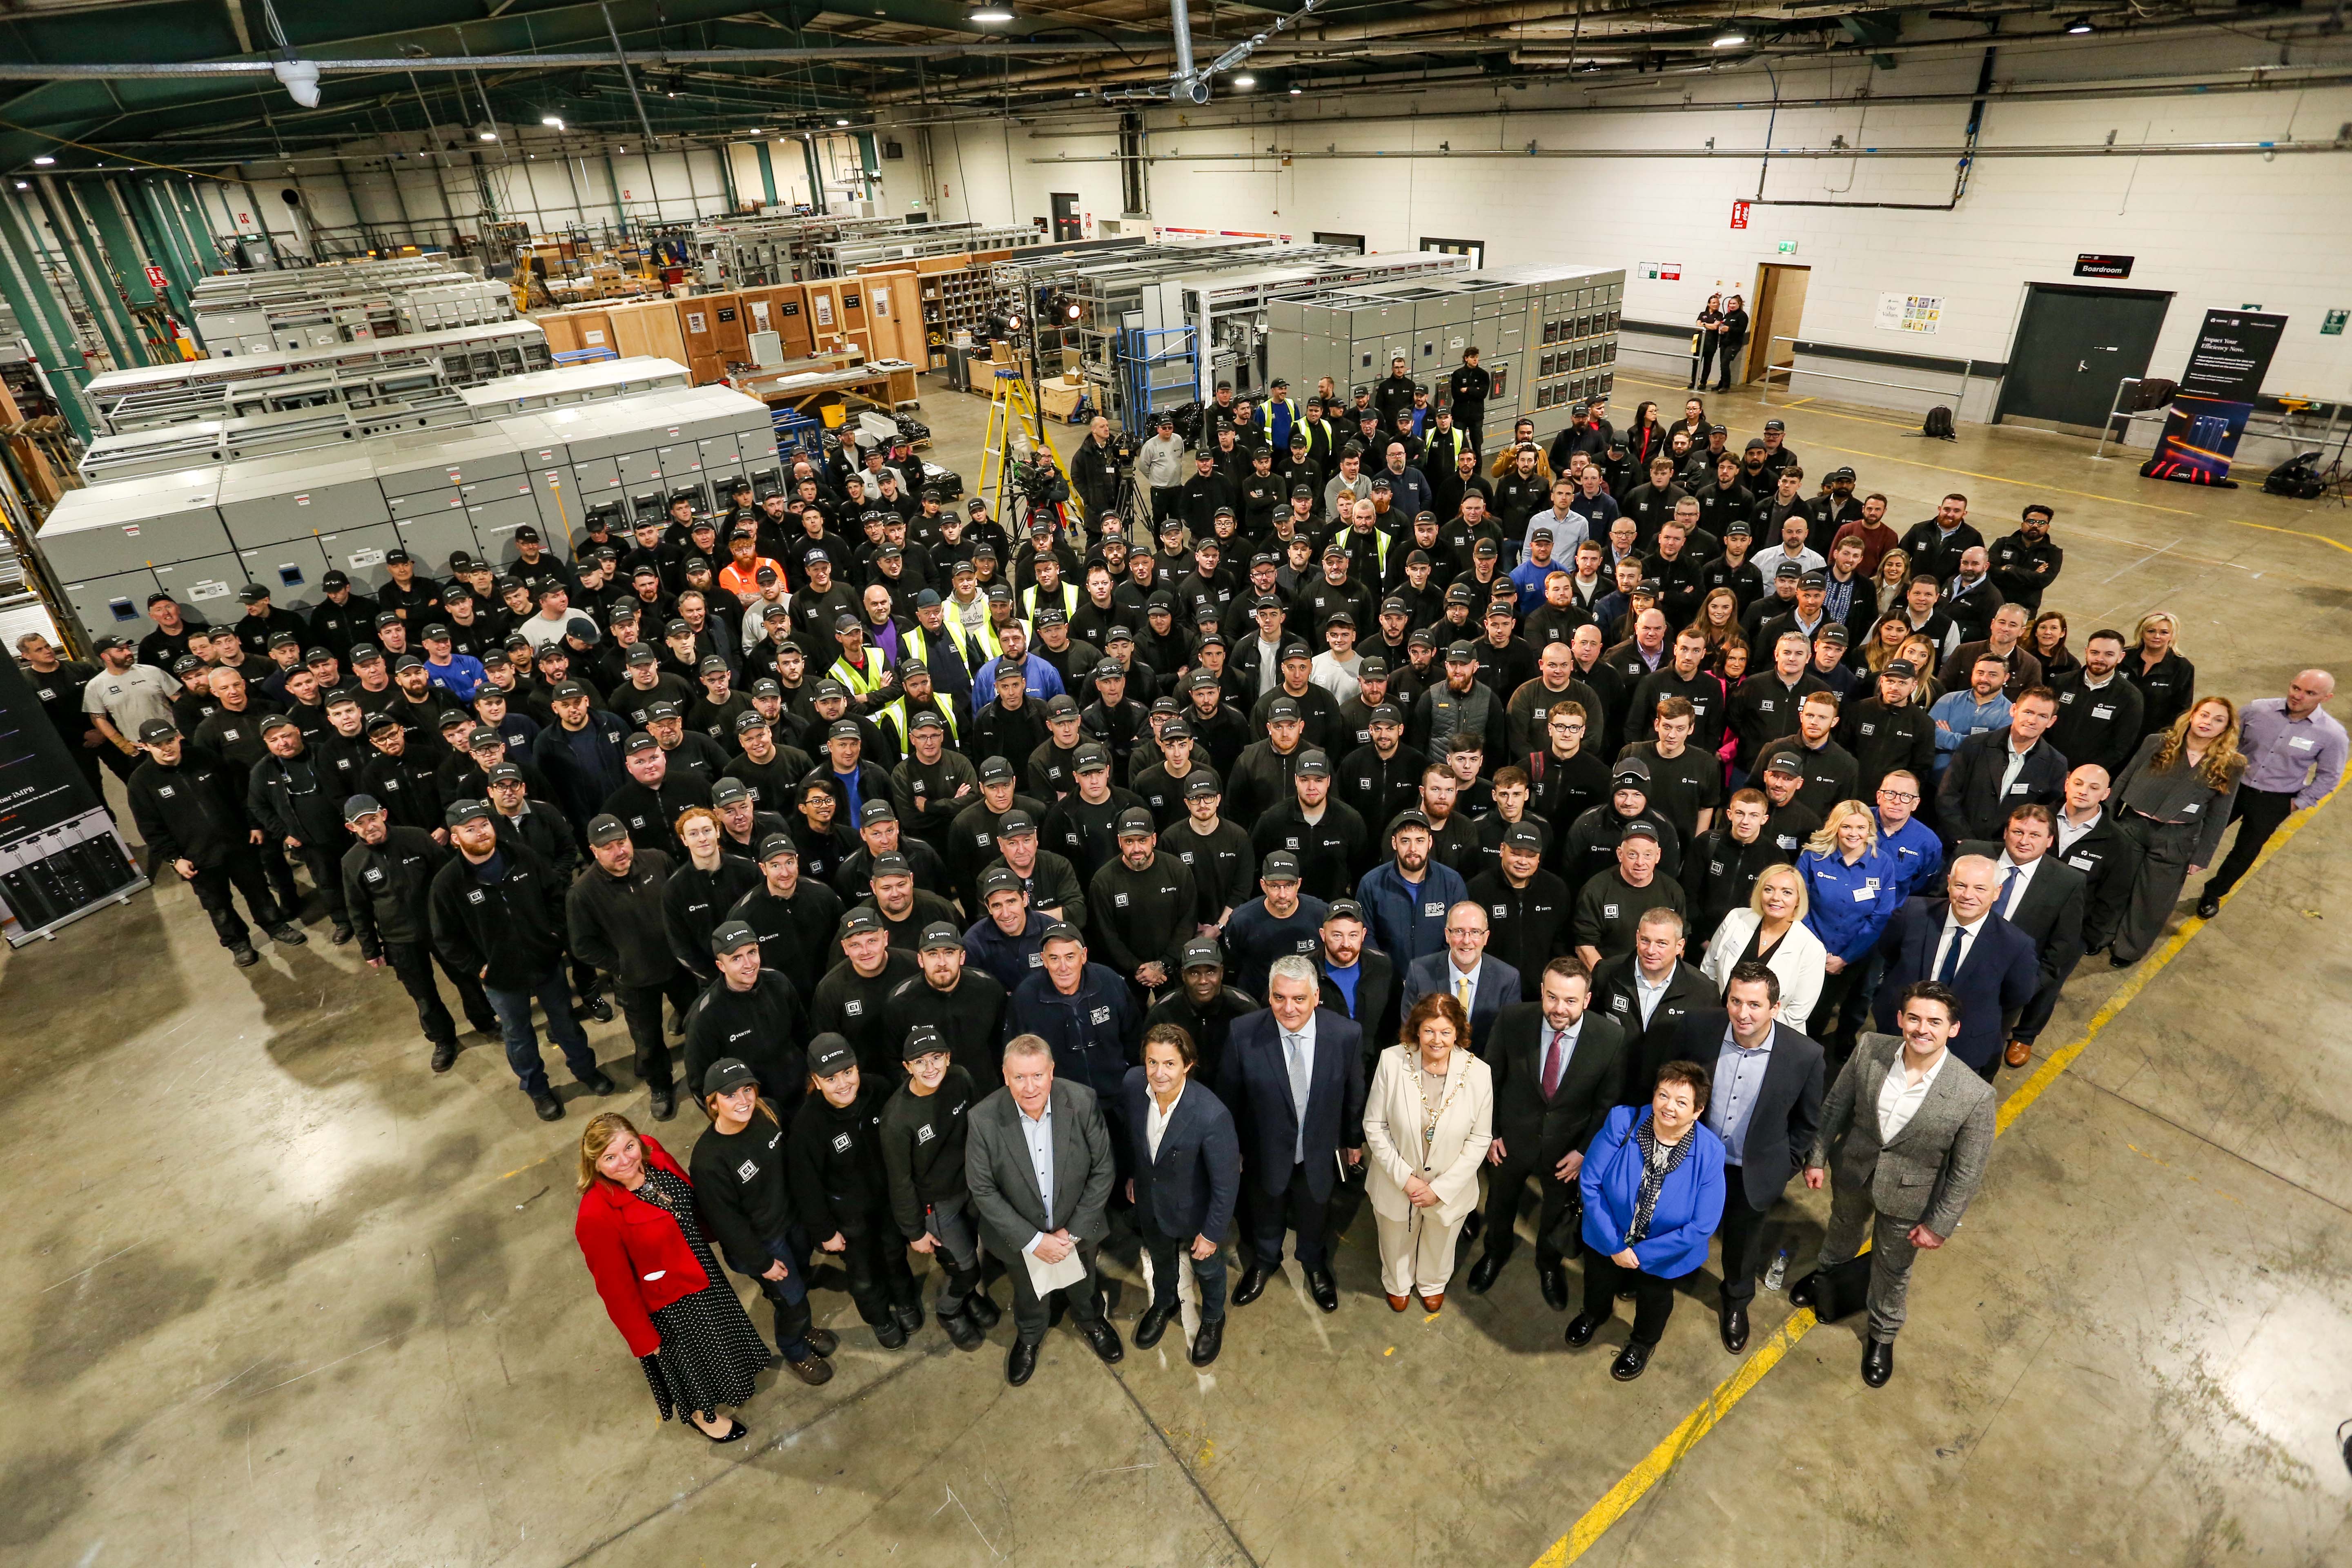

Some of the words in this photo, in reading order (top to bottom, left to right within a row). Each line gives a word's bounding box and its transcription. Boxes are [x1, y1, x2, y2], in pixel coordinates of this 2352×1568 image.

[2201, 343, 2229, 352] Efficiency
[12, 786, 35, 798] iMPB
[736, 1029, 751, 1038] VERTIV
[773, 1132, 782, 1143] VERTIV
